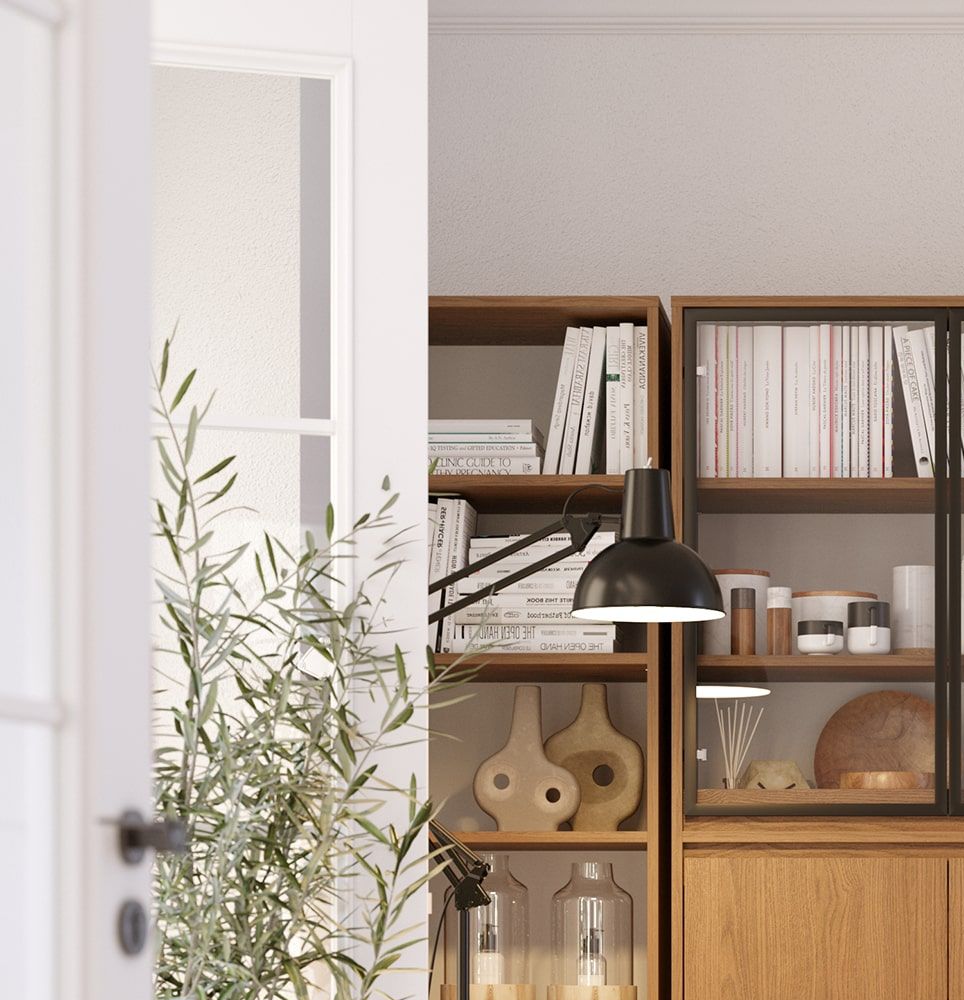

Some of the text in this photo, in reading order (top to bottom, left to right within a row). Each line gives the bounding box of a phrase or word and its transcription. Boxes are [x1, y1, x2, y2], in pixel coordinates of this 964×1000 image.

[903, 344, 913, 367] PIECE
[907, 367, 916, 379] OF
[909, 381, 919, 402] CAKE
[465, 457, 494, 467] GUIDE
[498, 457, 511, 467] TO
